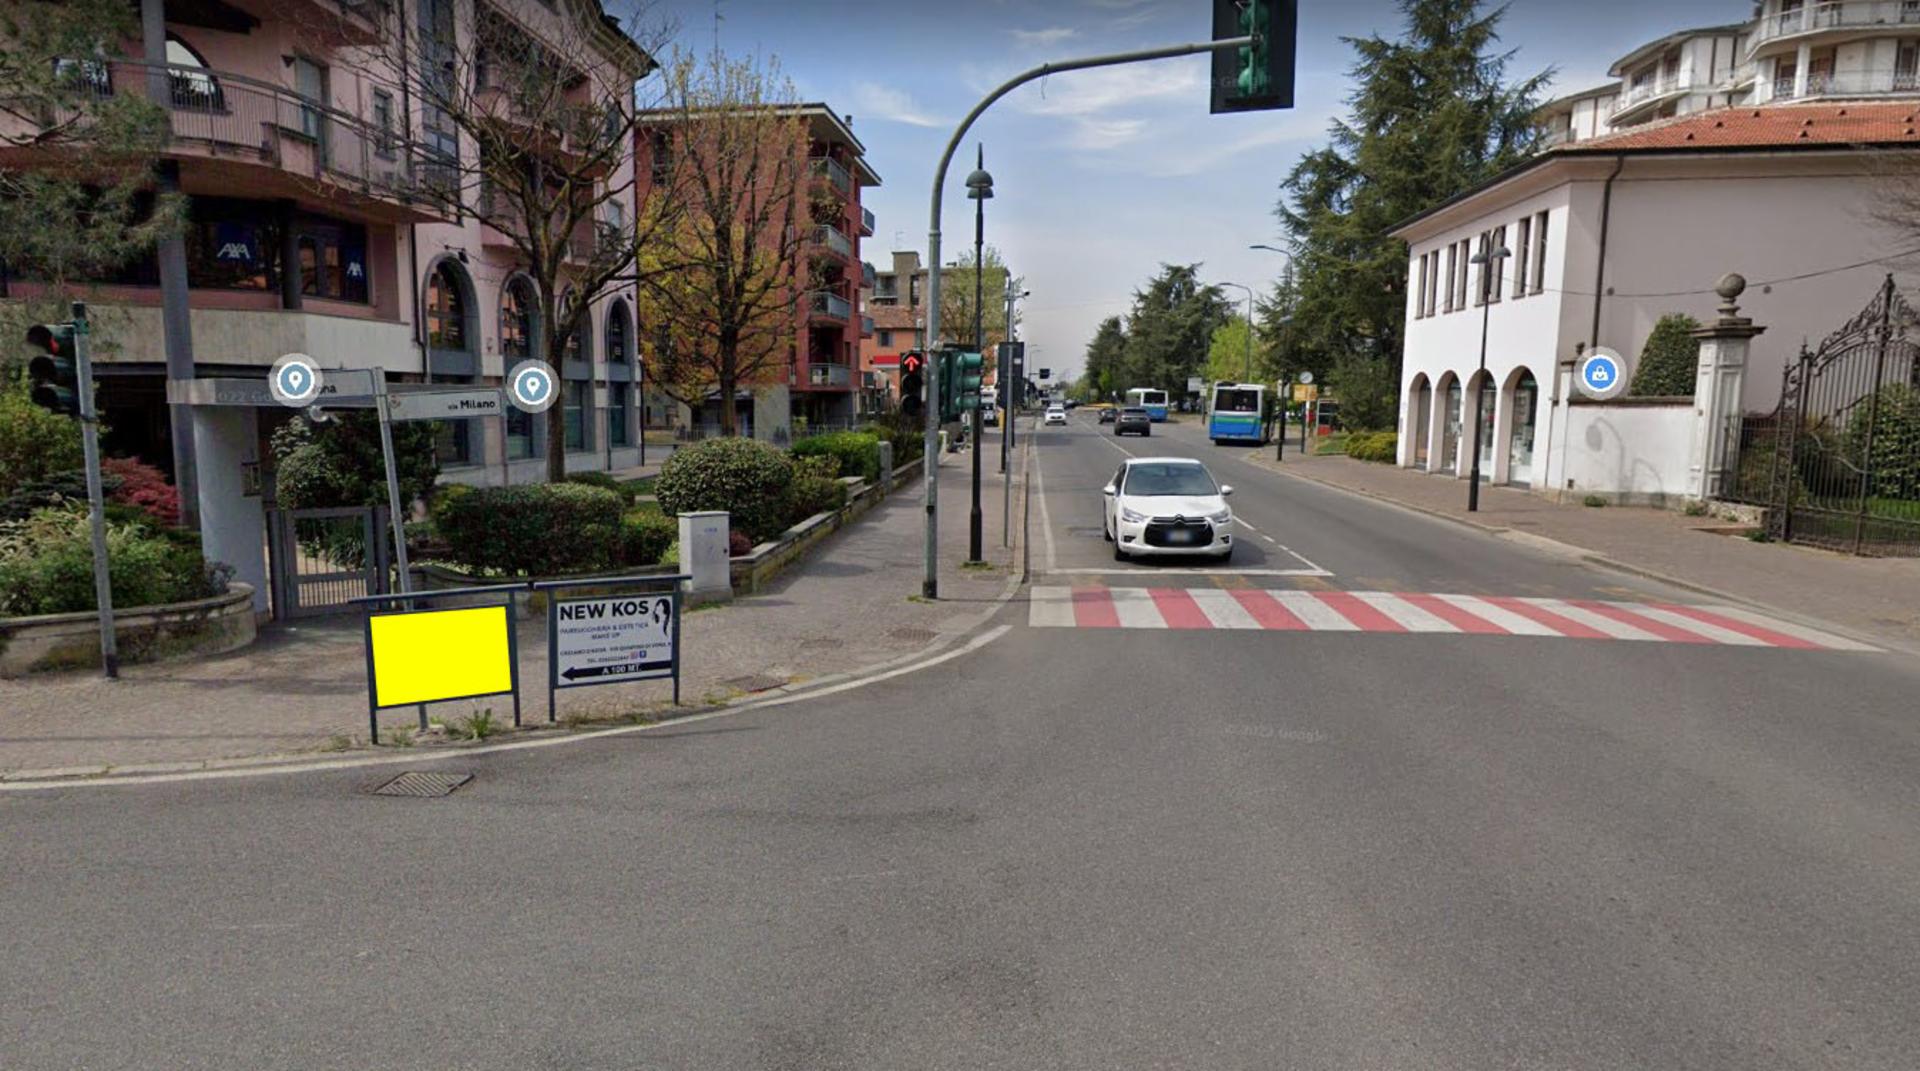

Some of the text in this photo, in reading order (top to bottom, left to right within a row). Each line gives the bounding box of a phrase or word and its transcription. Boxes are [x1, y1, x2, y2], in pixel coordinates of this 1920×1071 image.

[217, 242, 250, 259] AXA
[460, 399, 496, 409] Milano
[560, 600, 649, 620] NEW KOS
[602, 667, 609, 675] A
[611, 664, 626, 674] 100
